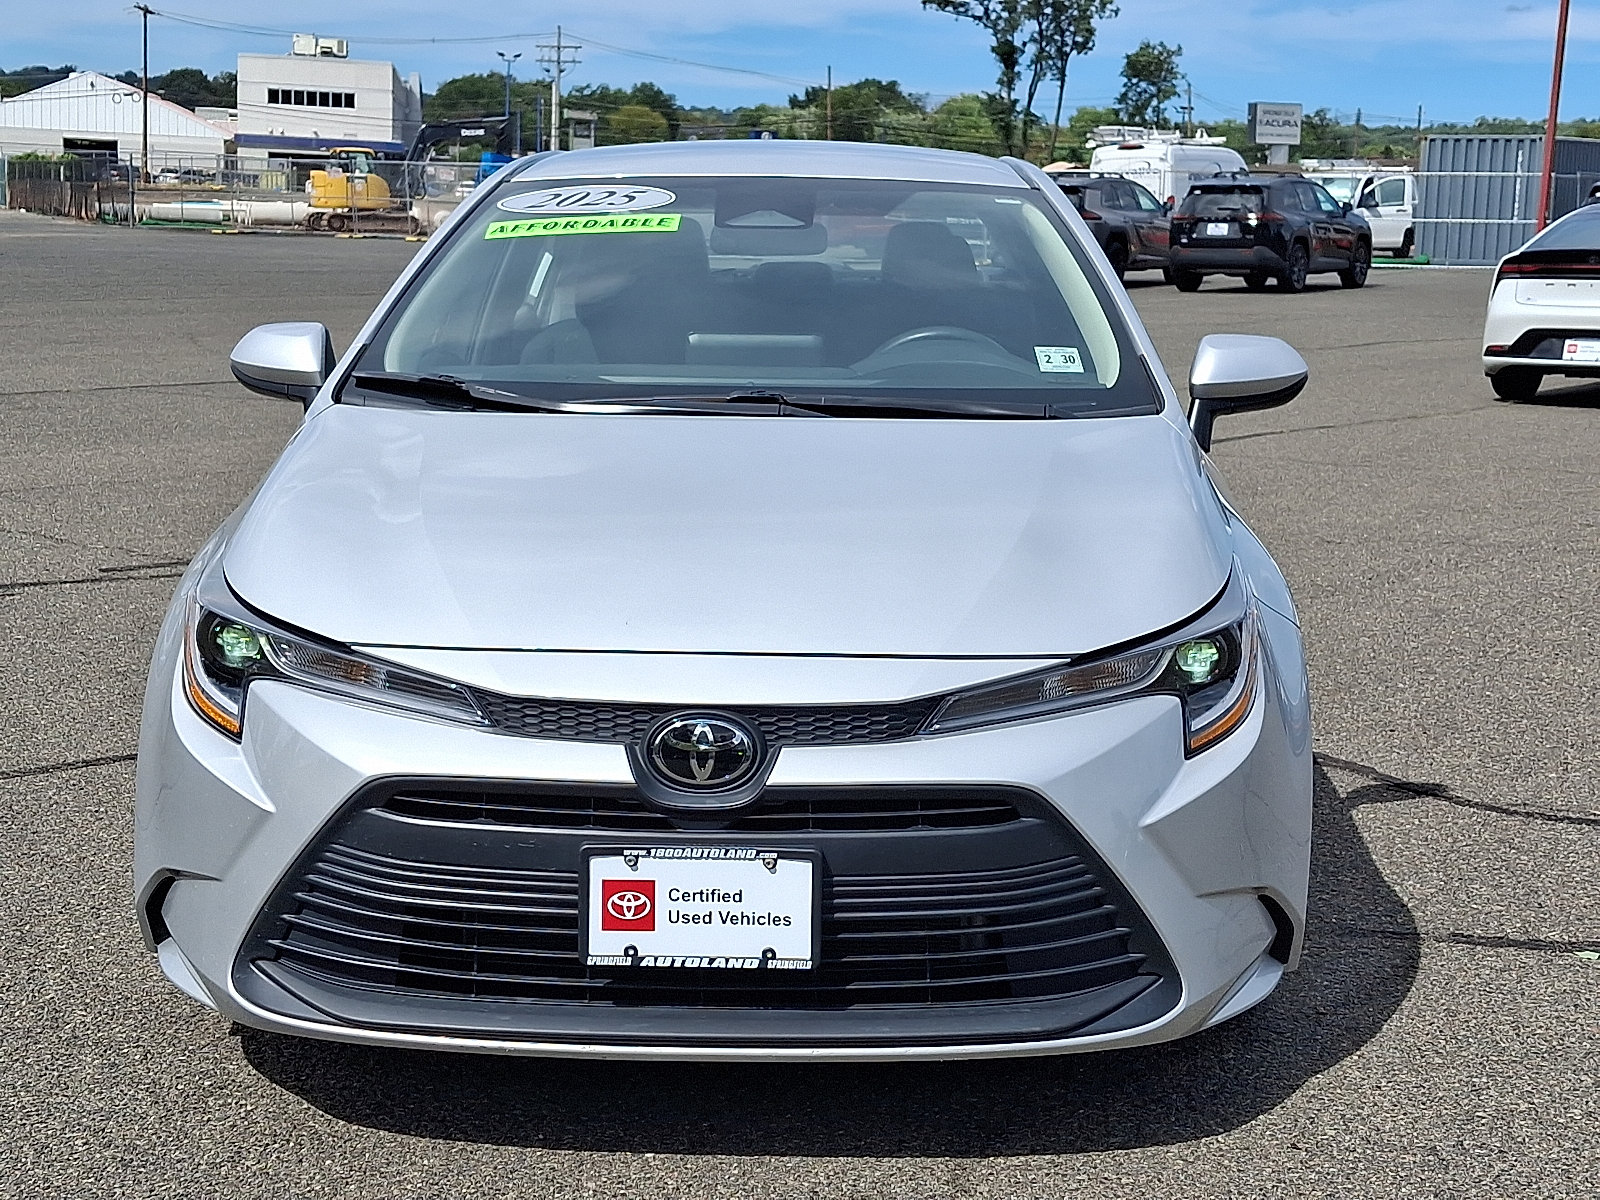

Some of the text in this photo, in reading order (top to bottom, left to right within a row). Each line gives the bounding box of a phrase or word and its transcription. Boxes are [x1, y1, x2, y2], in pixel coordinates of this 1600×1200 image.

[524, 190, 648, 209] 2025
[490, 217, 675, 235] AFFORDABLE
[1043, 354, 1076, 365] 2 30
[667, 887, 744, 904] Certified
[667, 909, 793, 927] Used Vehicles
[586, 955, 633, 966] SPRINGFIELD
[639, 956, 760, 969] AUTOLAND
